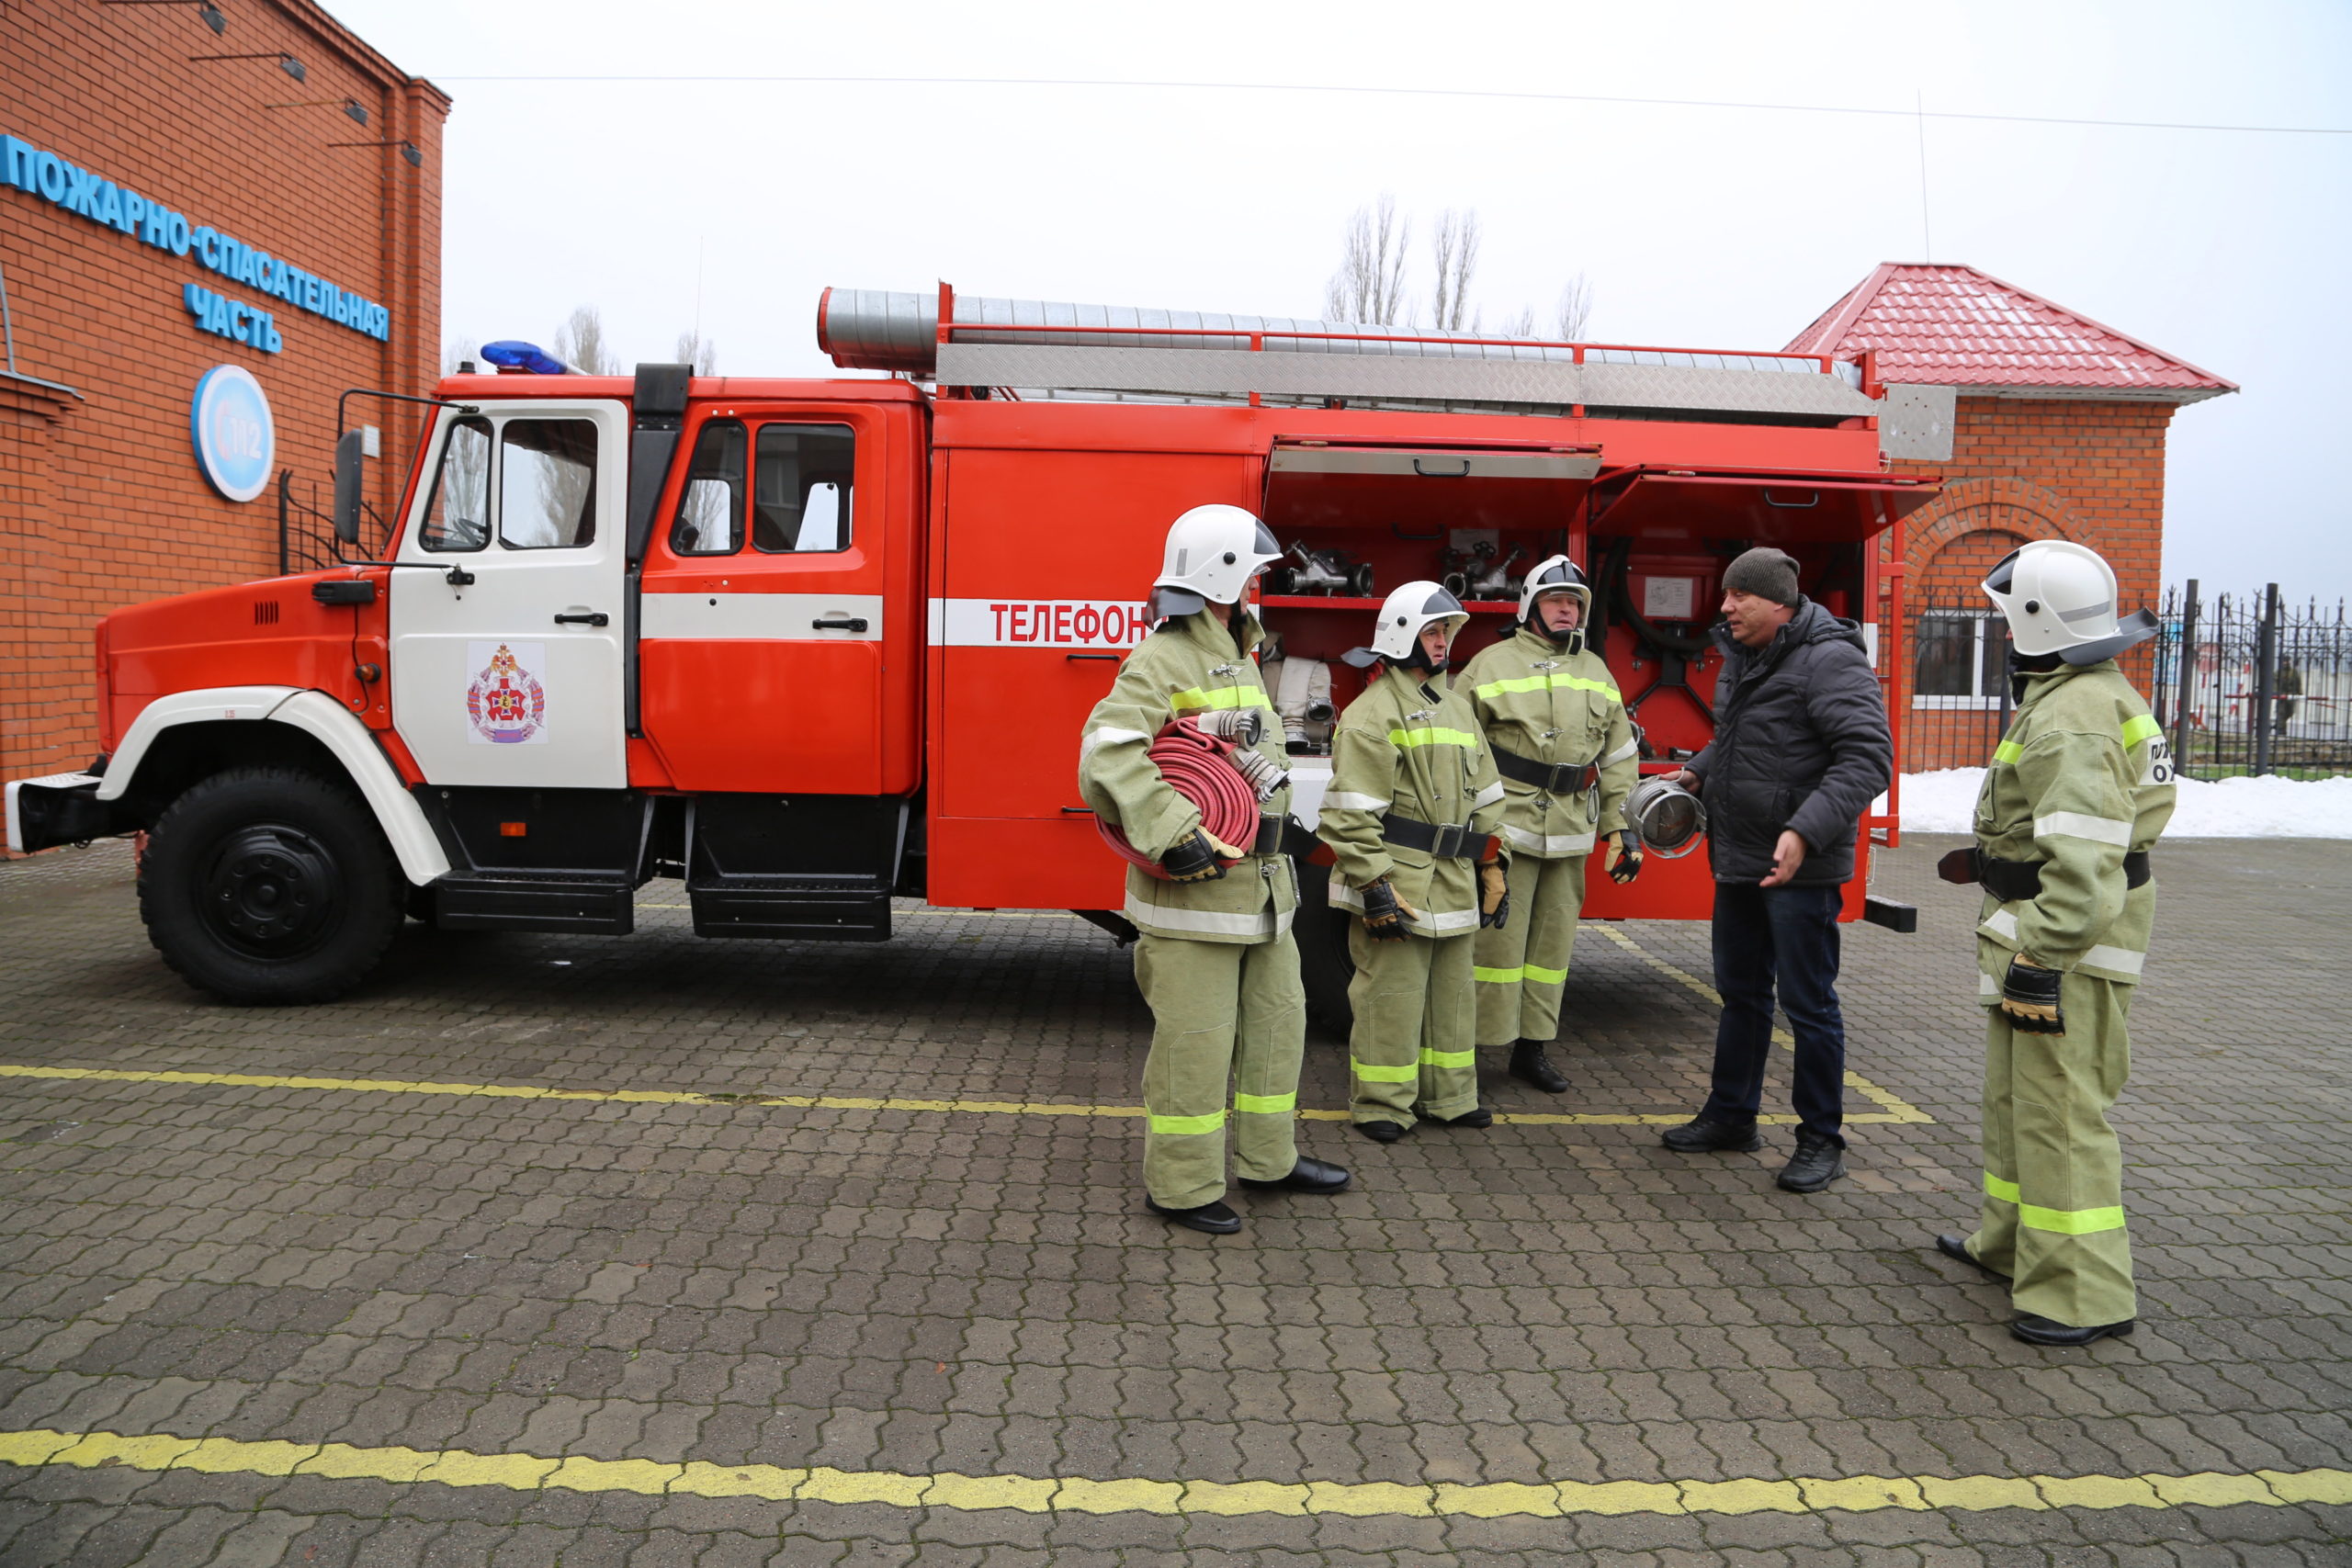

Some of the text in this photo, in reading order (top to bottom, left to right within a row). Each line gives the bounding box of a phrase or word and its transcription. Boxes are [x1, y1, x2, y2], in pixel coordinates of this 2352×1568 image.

[0, 134, 389, 341] ПОЖАРНО-СПАСАТЕЛЬНАЯ
[184, 283, 283, 354] ЧАСТЬ
[230, 416, 262, 459] 112
[989, 604, 1148, 644] ТЕЛЕФОН
